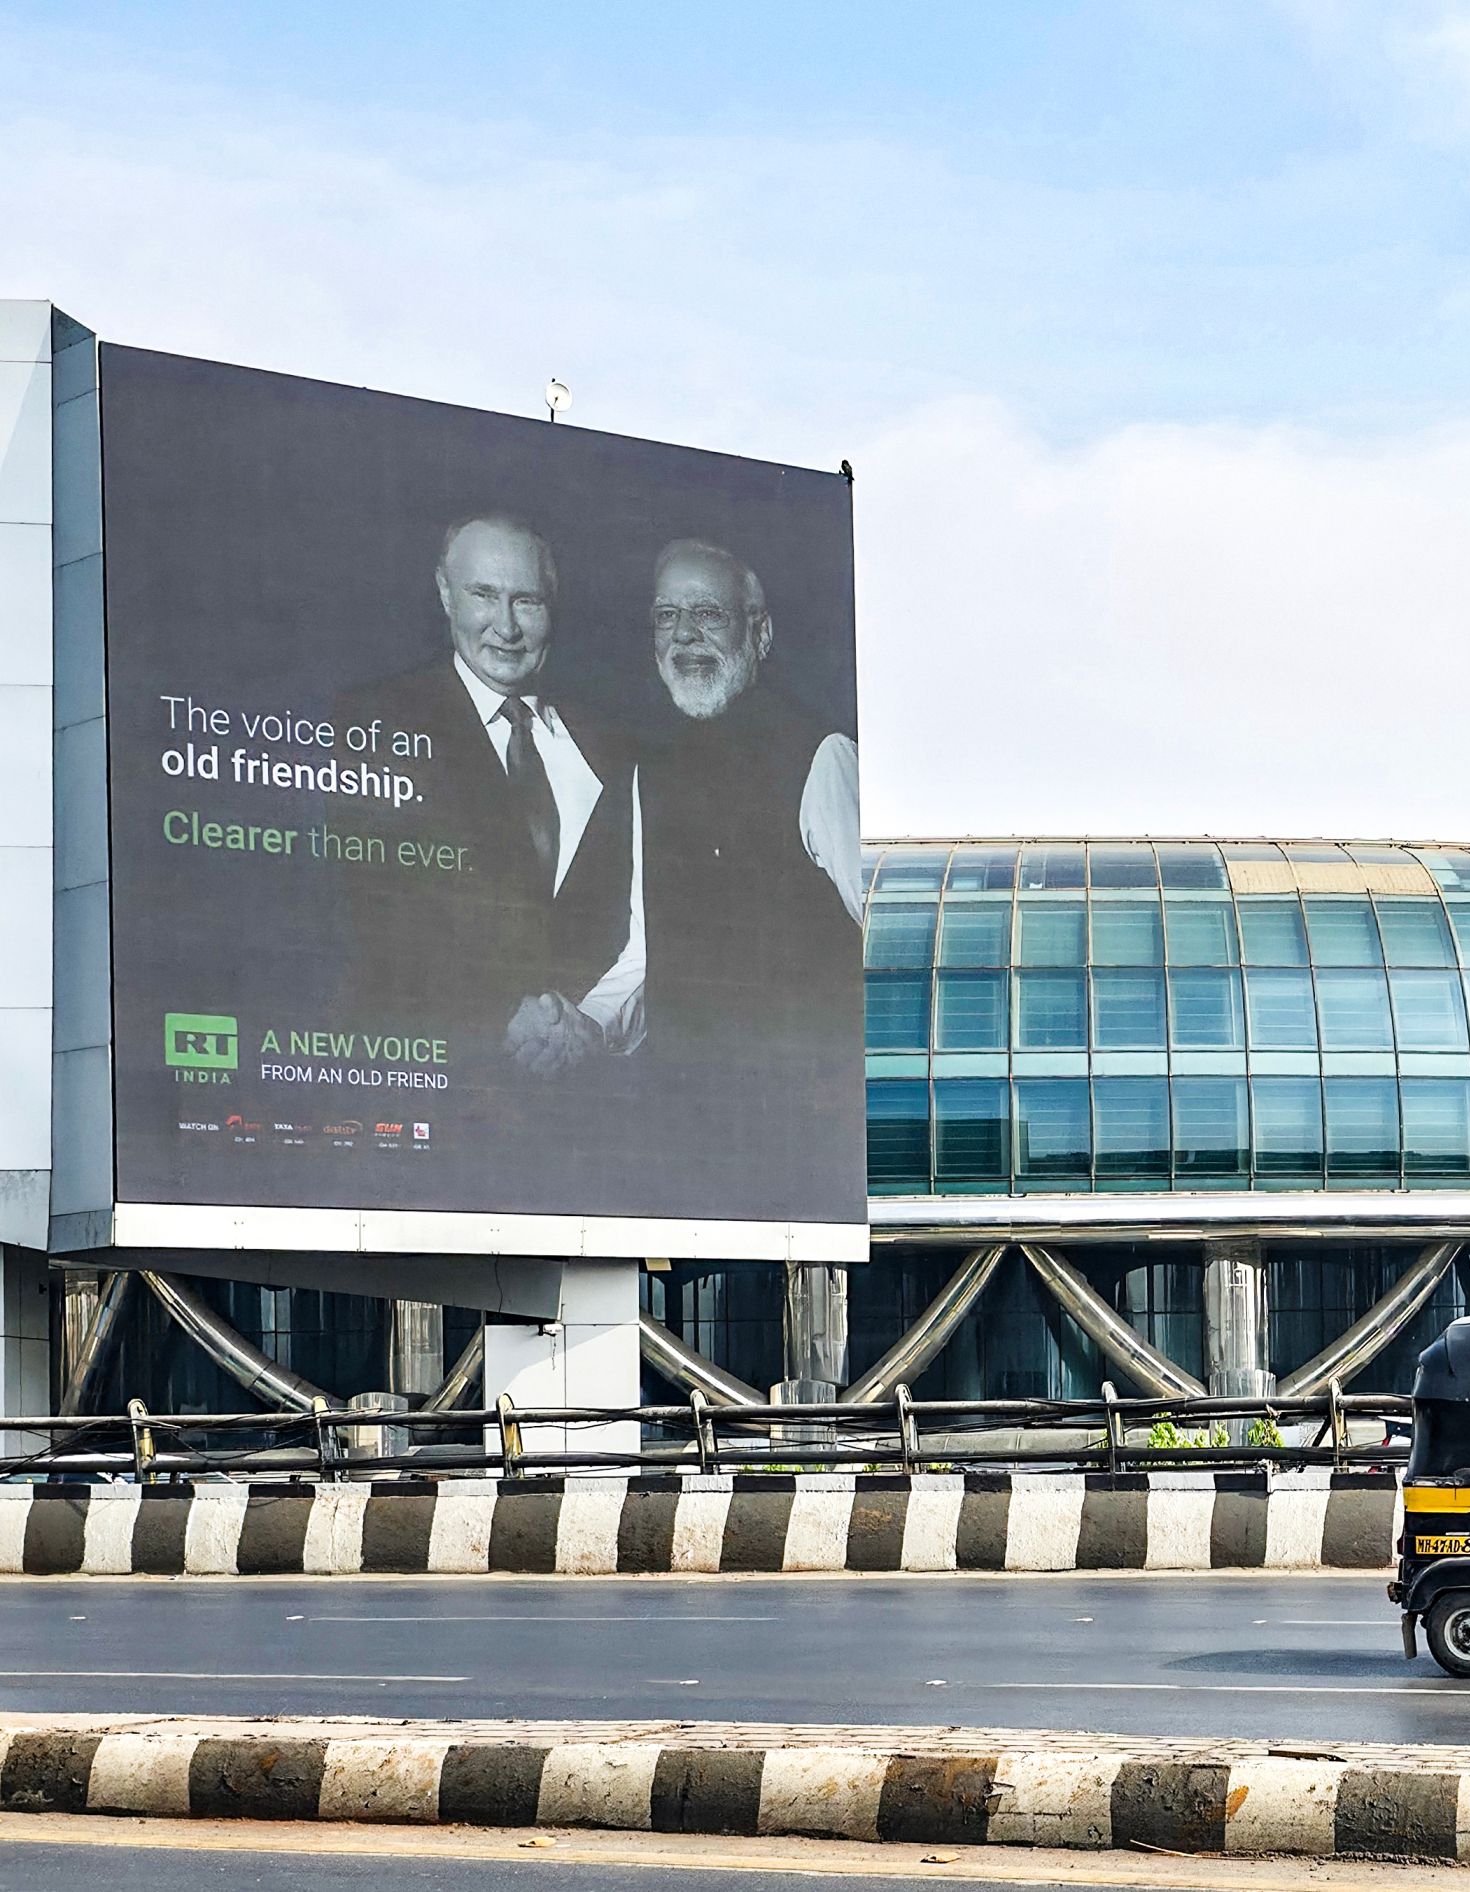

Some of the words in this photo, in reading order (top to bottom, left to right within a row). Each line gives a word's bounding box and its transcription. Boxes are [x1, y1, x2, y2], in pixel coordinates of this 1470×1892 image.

[160, 695, 231, 736] The
[241, 710, 335, 748] voice
[346, 719, 383, 753] of
[391, 731, 433, 760] an
[161, 743, 219, 781] old
[231, 748, 425, 808] friendship.
[163, 810, 298, 856] Clearer
[308, 825, 386, 864] than
[397, 840, 475, 872] ever.
[174, 1030, 239, 1056] RT
[260, 1029, 281, 1055] A
[290, 1031, 355, 1059] NEW
[363, 1034, 448, 1065] VOICE
[175, 1069, 232, 1084] INDIA
[261, 1063, 313, 1084] FROM
[319, 1067, 344, 1085] AN
[349, 1068, 383, 1087] OLD
[387, 1071, 449, 1090] FRIEND
[178, 1122, 207, 1131] WATCH
